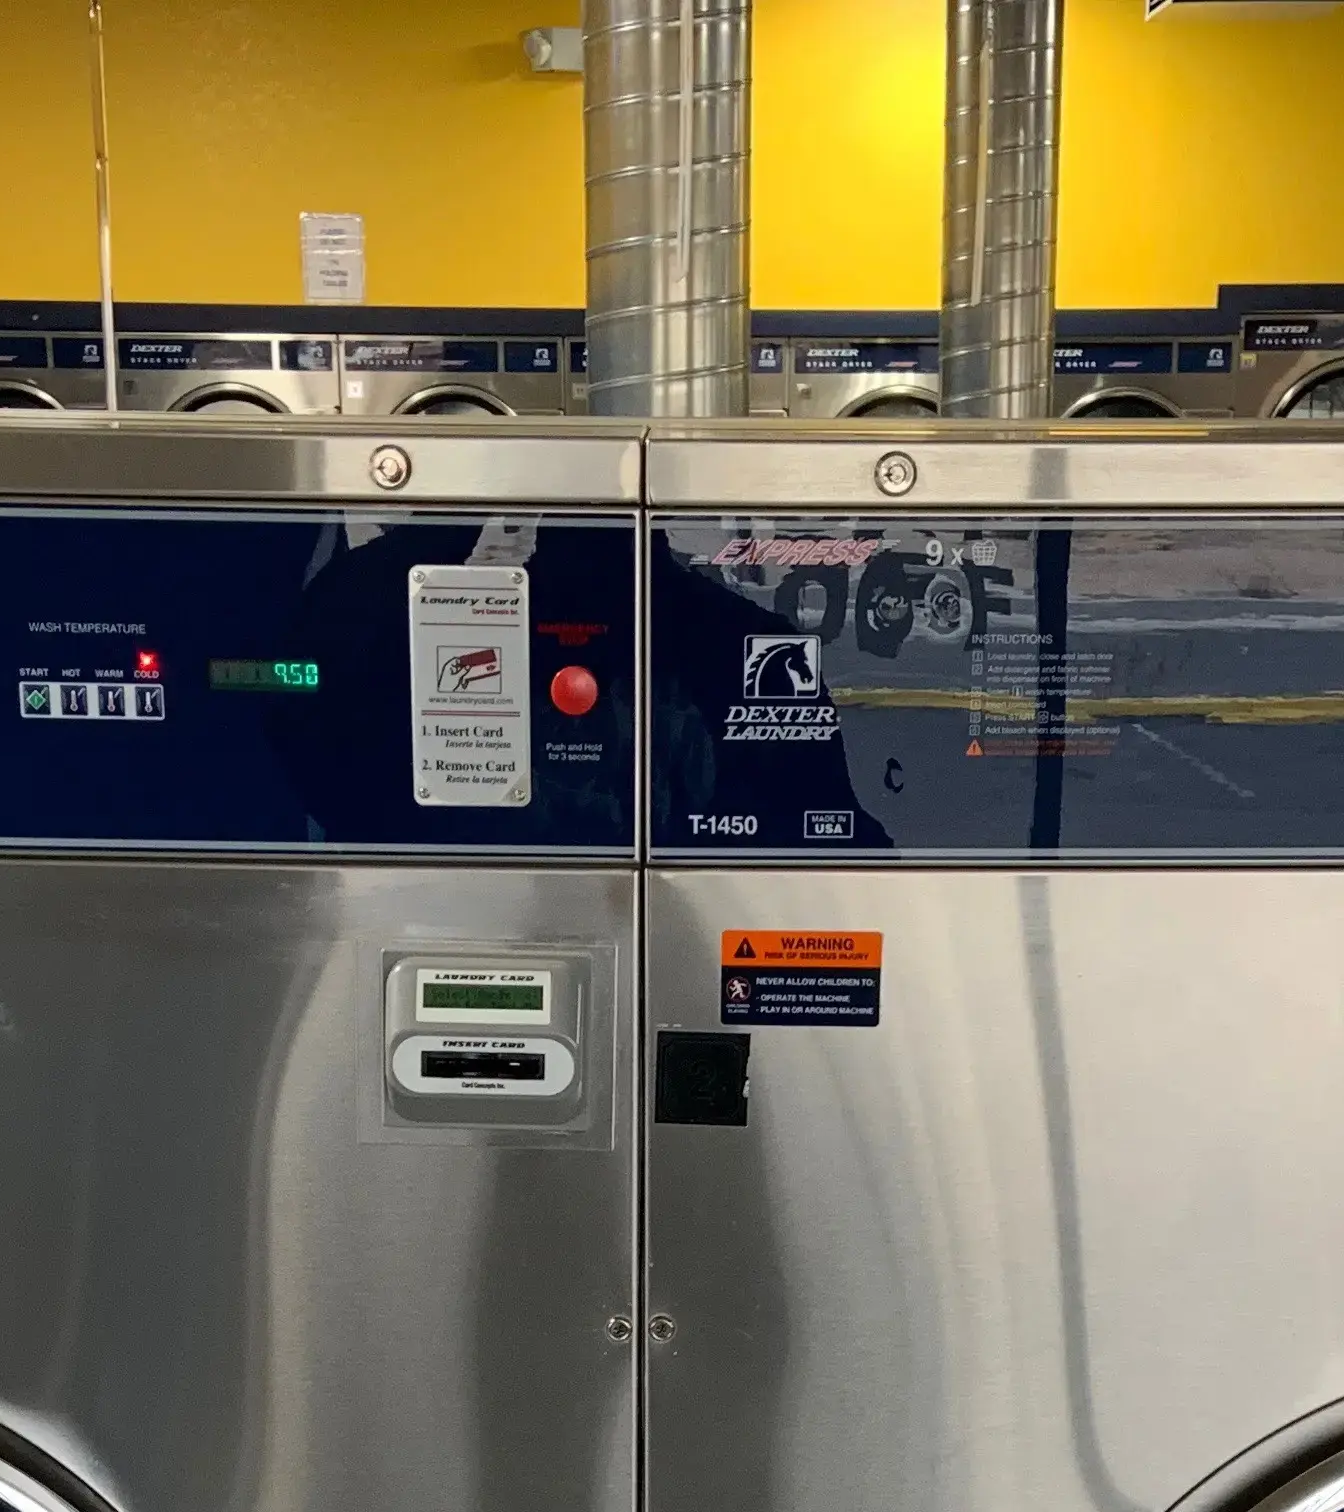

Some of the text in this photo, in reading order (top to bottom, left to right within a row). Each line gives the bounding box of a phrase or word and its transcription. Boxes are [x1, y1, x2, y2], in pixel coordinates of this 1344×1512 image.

[1258, 325, 1309, 333] DEXTER
[131, 345, 183, 353] DEXTER
[807, 349, 859, 357] DEXTER
[712, 538, 878, 566] EXPRESS
[925, 540, 943, 566] 9
[420, 596, 520, 606] Laundry Card
[28, 622, 146, 633] WASH TEMPERATURE
[971, 634, 1053, 644] INSTRUCTIONS
[19, 669, 159, 678] START HOT WARM COLD
[724, 706, 836, 723] DEXTER
[422, 726, 504, 737] 1. Insert Card
[723, 725, 840, 740] LAUNDRY
[422, 761, 516, 772] 2. Remove Card
[689, 814, 758, 835] T-1450
[814, 822, 843, 834] USA
[781, 938, 854, 950] WARNING
[818, 978, 860, 986] CHILDREN
